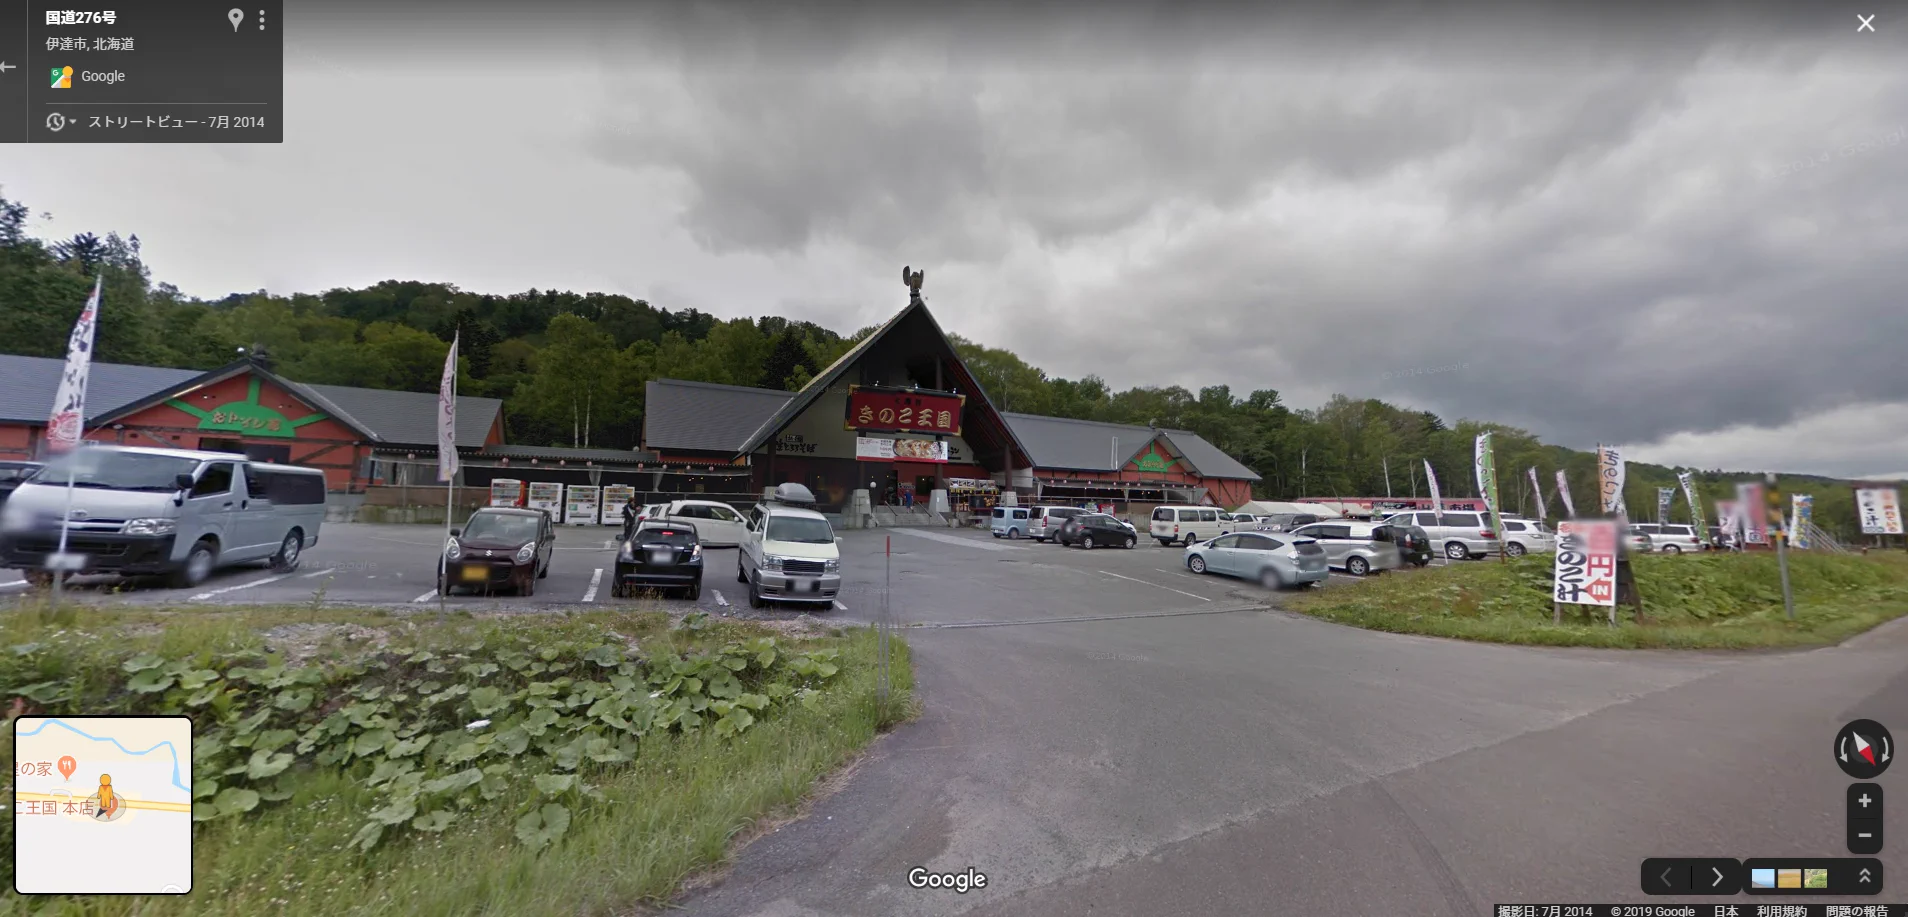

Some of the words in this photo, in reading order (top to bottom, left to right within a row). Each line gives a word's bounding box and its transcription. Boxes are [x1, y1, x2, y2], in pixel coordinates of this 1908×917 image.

[858, 405, 951, 428] きのこ王国
[1592, 585, 1608, 596] IN
